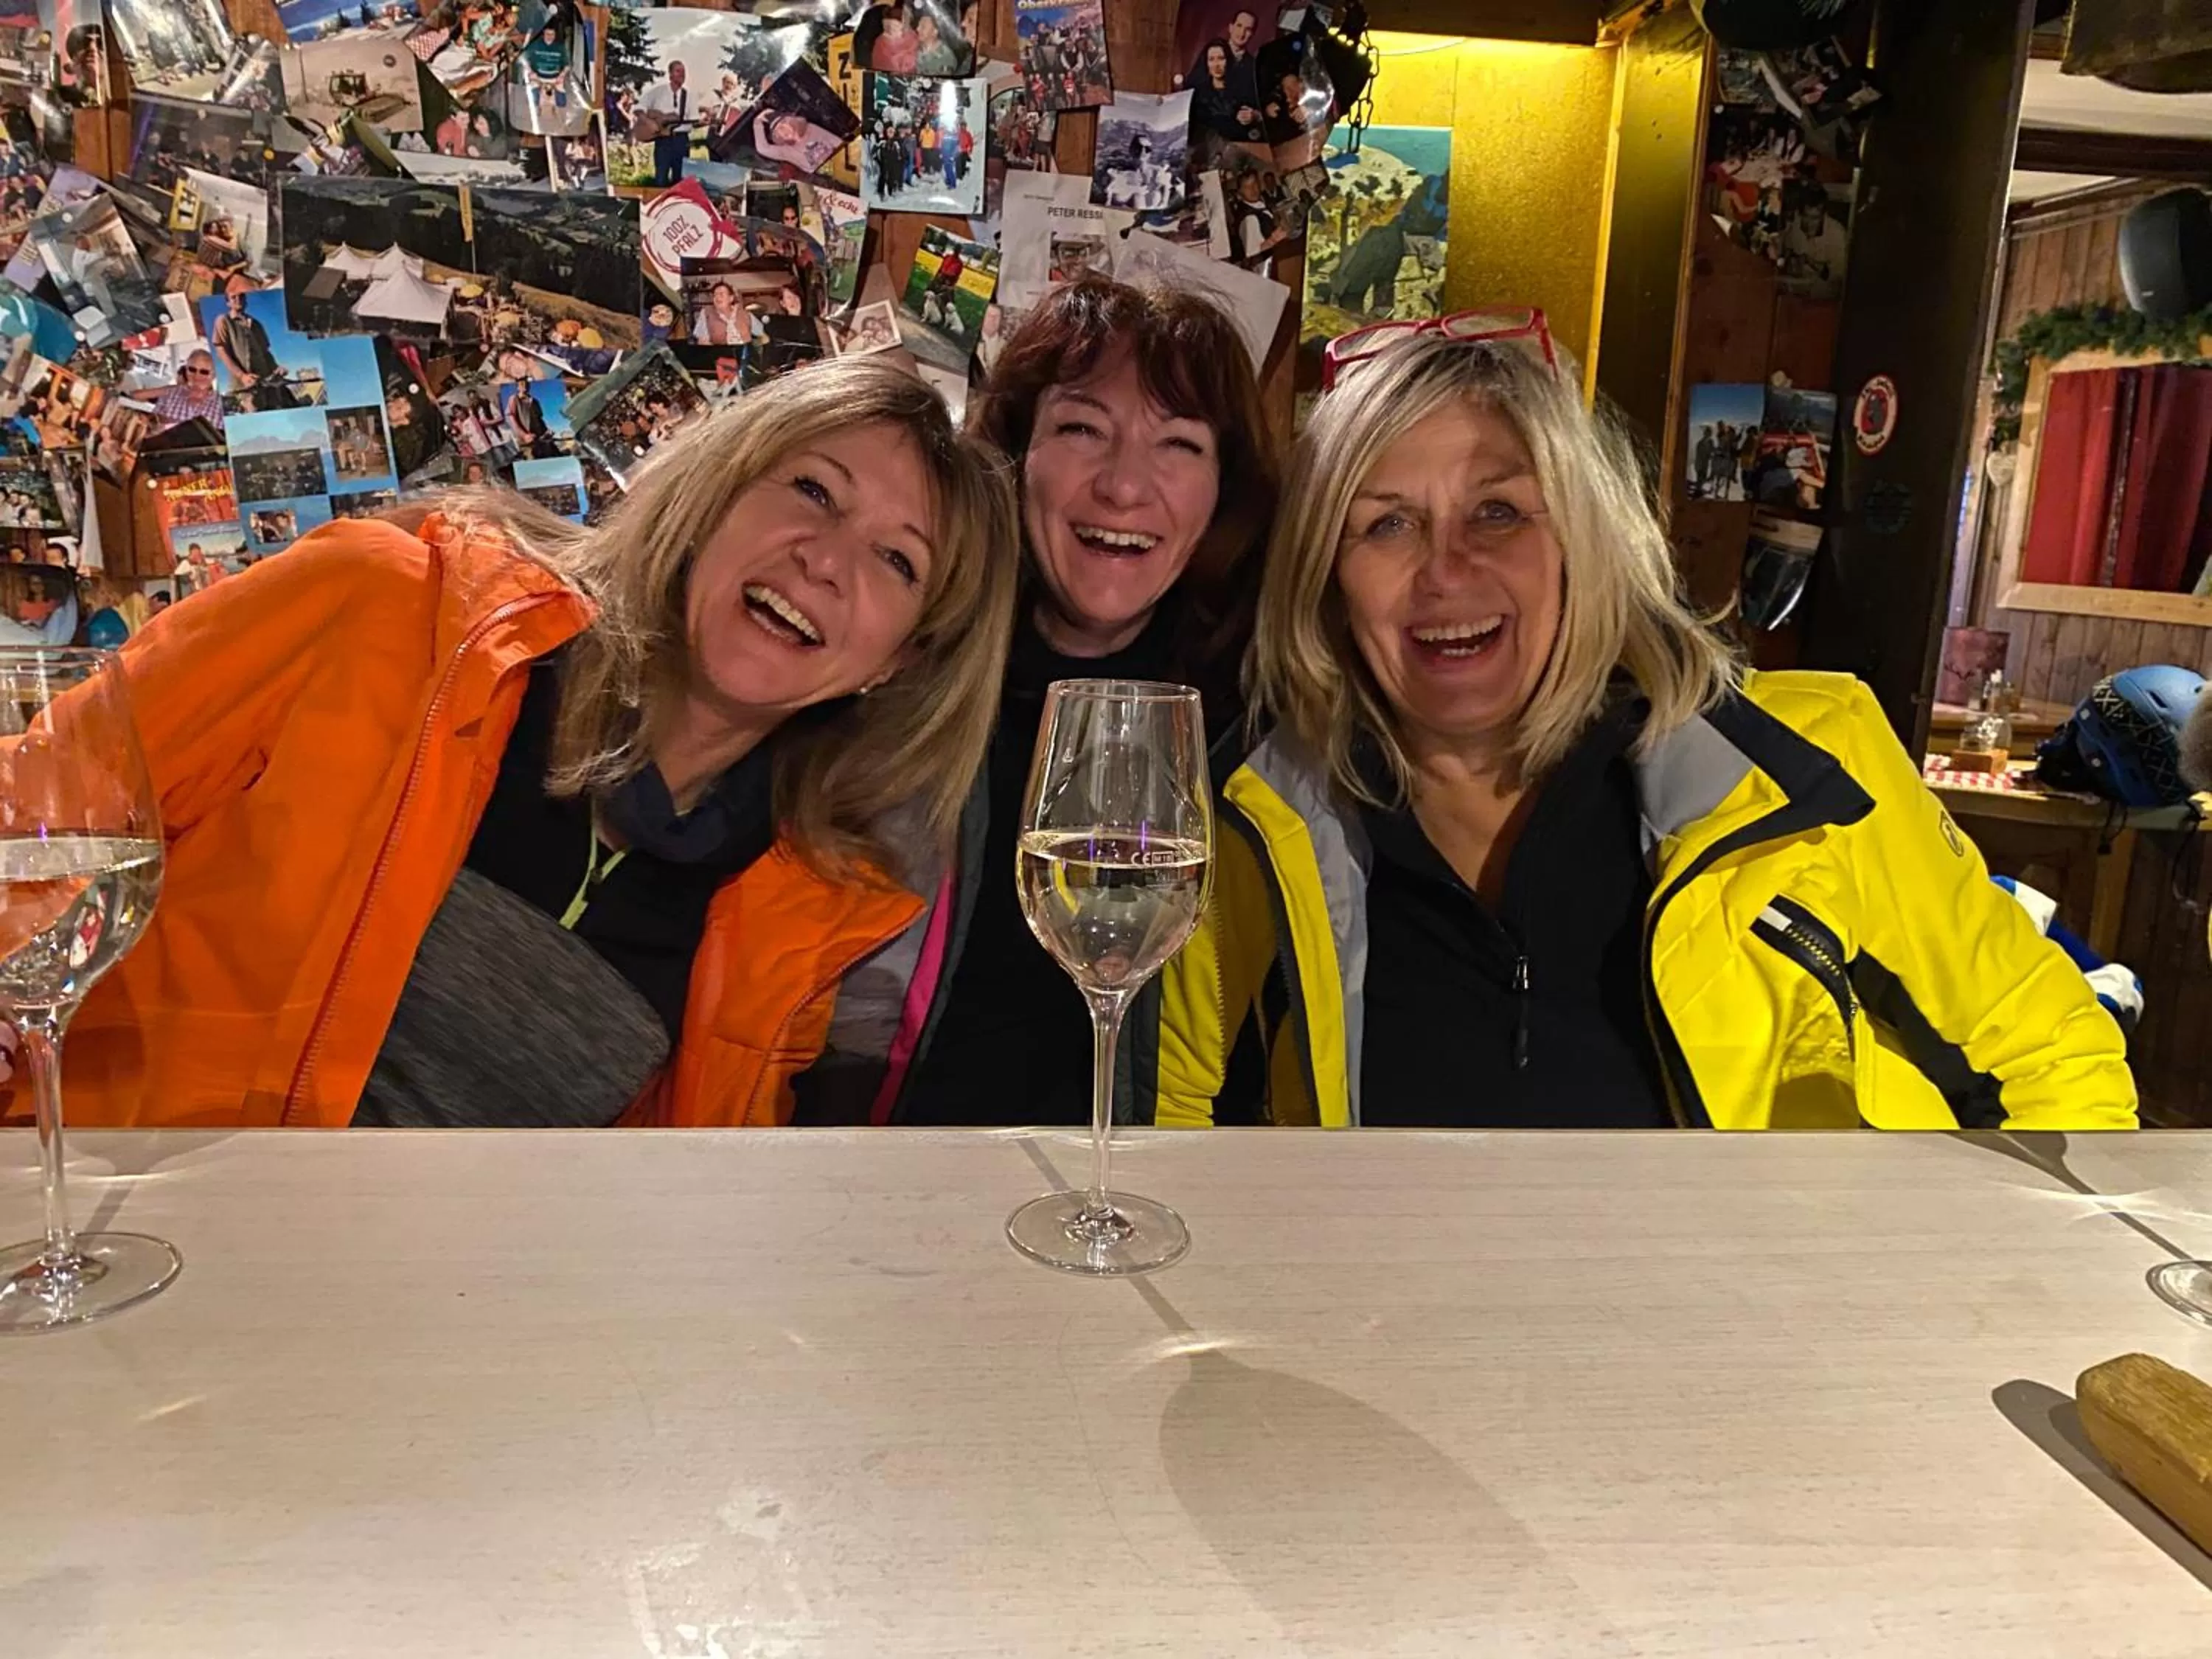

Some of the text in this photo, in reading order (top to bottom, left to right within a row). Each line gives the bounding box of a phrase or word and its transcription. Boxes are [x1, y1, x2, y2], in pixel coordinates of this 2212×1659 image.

[1048, 206, 1076, 218] PETER
[663, 215, 689, 243] 100%
[672, 223, 703, 255] PFALZ
